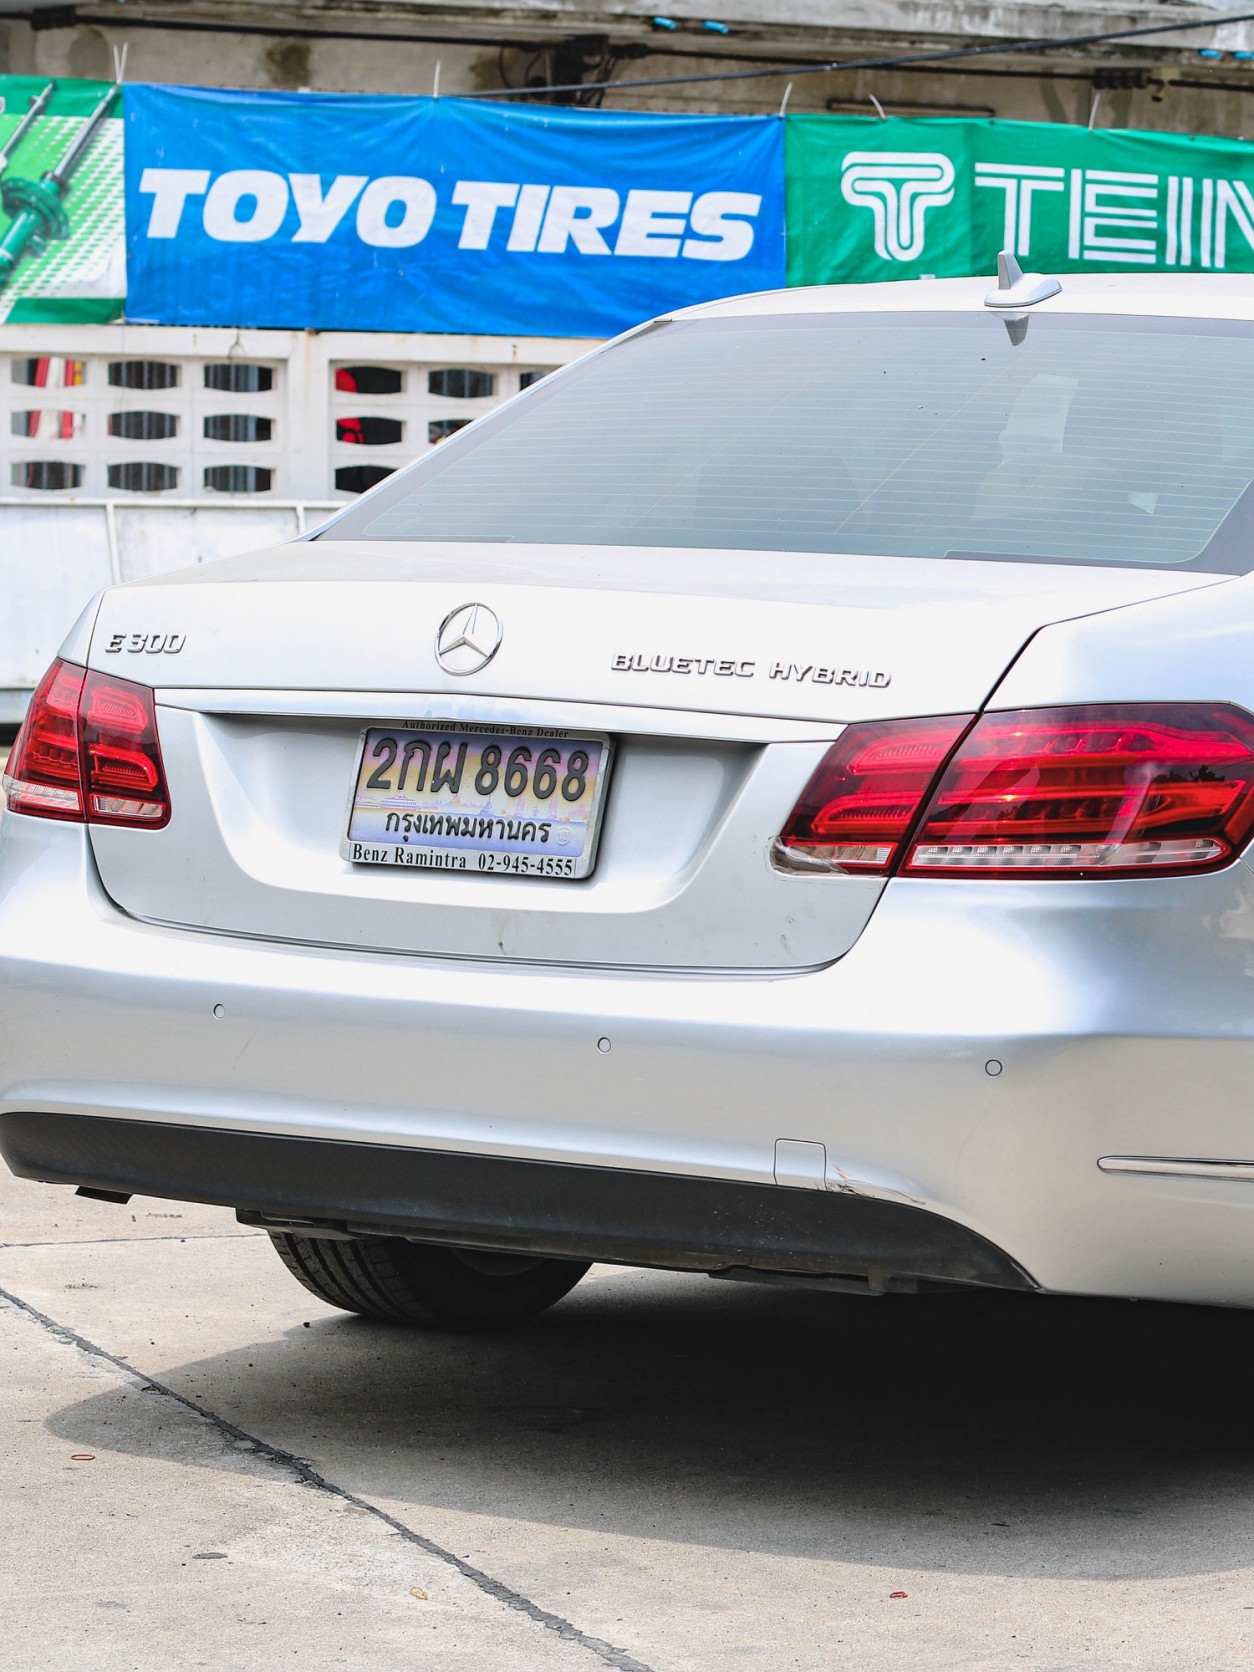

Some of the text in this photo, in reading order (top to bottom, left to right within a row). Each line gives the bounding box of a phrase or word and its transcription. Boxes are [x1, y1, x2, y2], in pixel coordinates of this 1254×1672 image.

[139, 169, 763, 262] TOYO TIRES
[104, 632, 187, 655] E 300
[610, 652, 893, 689] BLUETEC HYBRID
[402, 719, 570, 739] Authorized Mercedes-Benz Dealer
[366, 737, 590, 802] 2กผ 8668
[385, 811, 552, 844] กรุงเทพมหานคร
[352, 843, 573, 877] Benz Ramintra 02-945-4555
